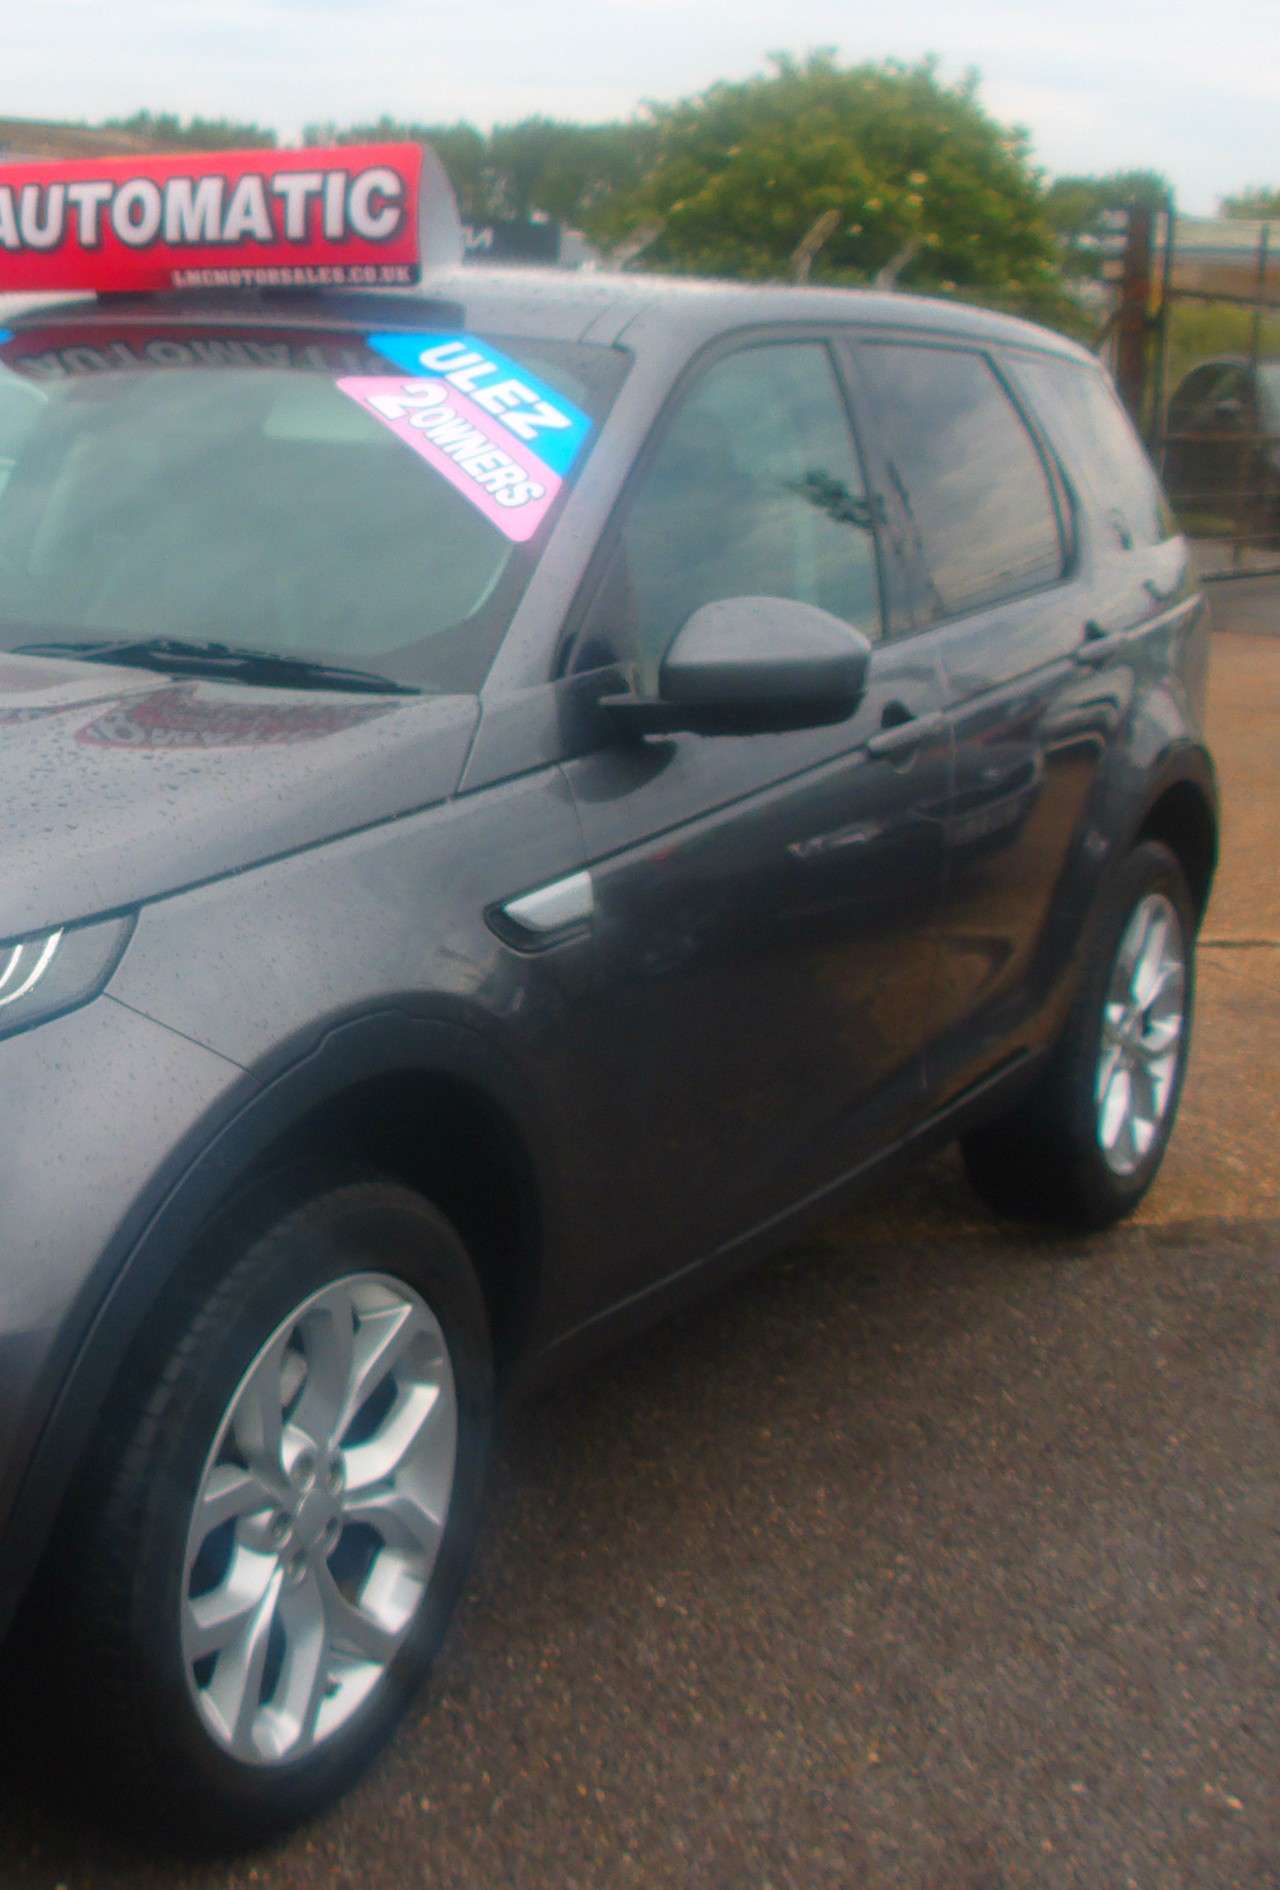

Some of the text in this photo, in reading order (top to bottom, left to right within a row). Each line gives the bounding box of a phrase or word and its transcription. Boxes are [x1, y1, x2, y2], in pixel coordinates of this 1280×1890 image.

[368, 382, 546, 508] 2 OWNERS
[419, 341, 572, 440] ULEZ
